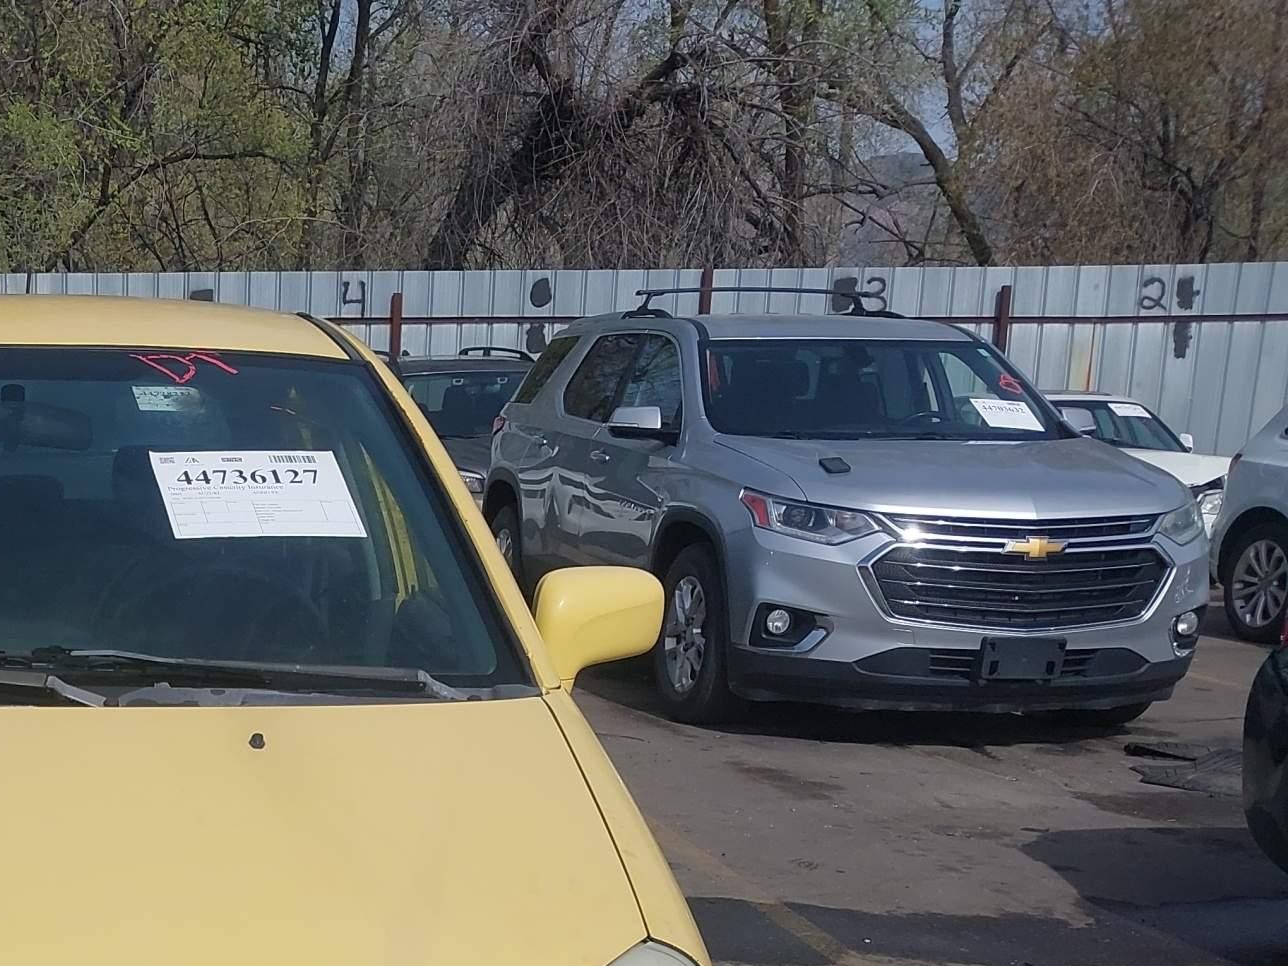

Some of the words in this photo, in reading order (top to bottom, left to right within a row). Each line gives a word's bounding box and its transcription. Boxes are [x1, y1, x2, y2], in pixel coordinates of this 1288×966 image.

[342, 280, 366, 318] 4
[865, 276, 888, 313] 3
[1140, 276, 1167, 310] 2
[176, 469, 318, 485] 44736127
